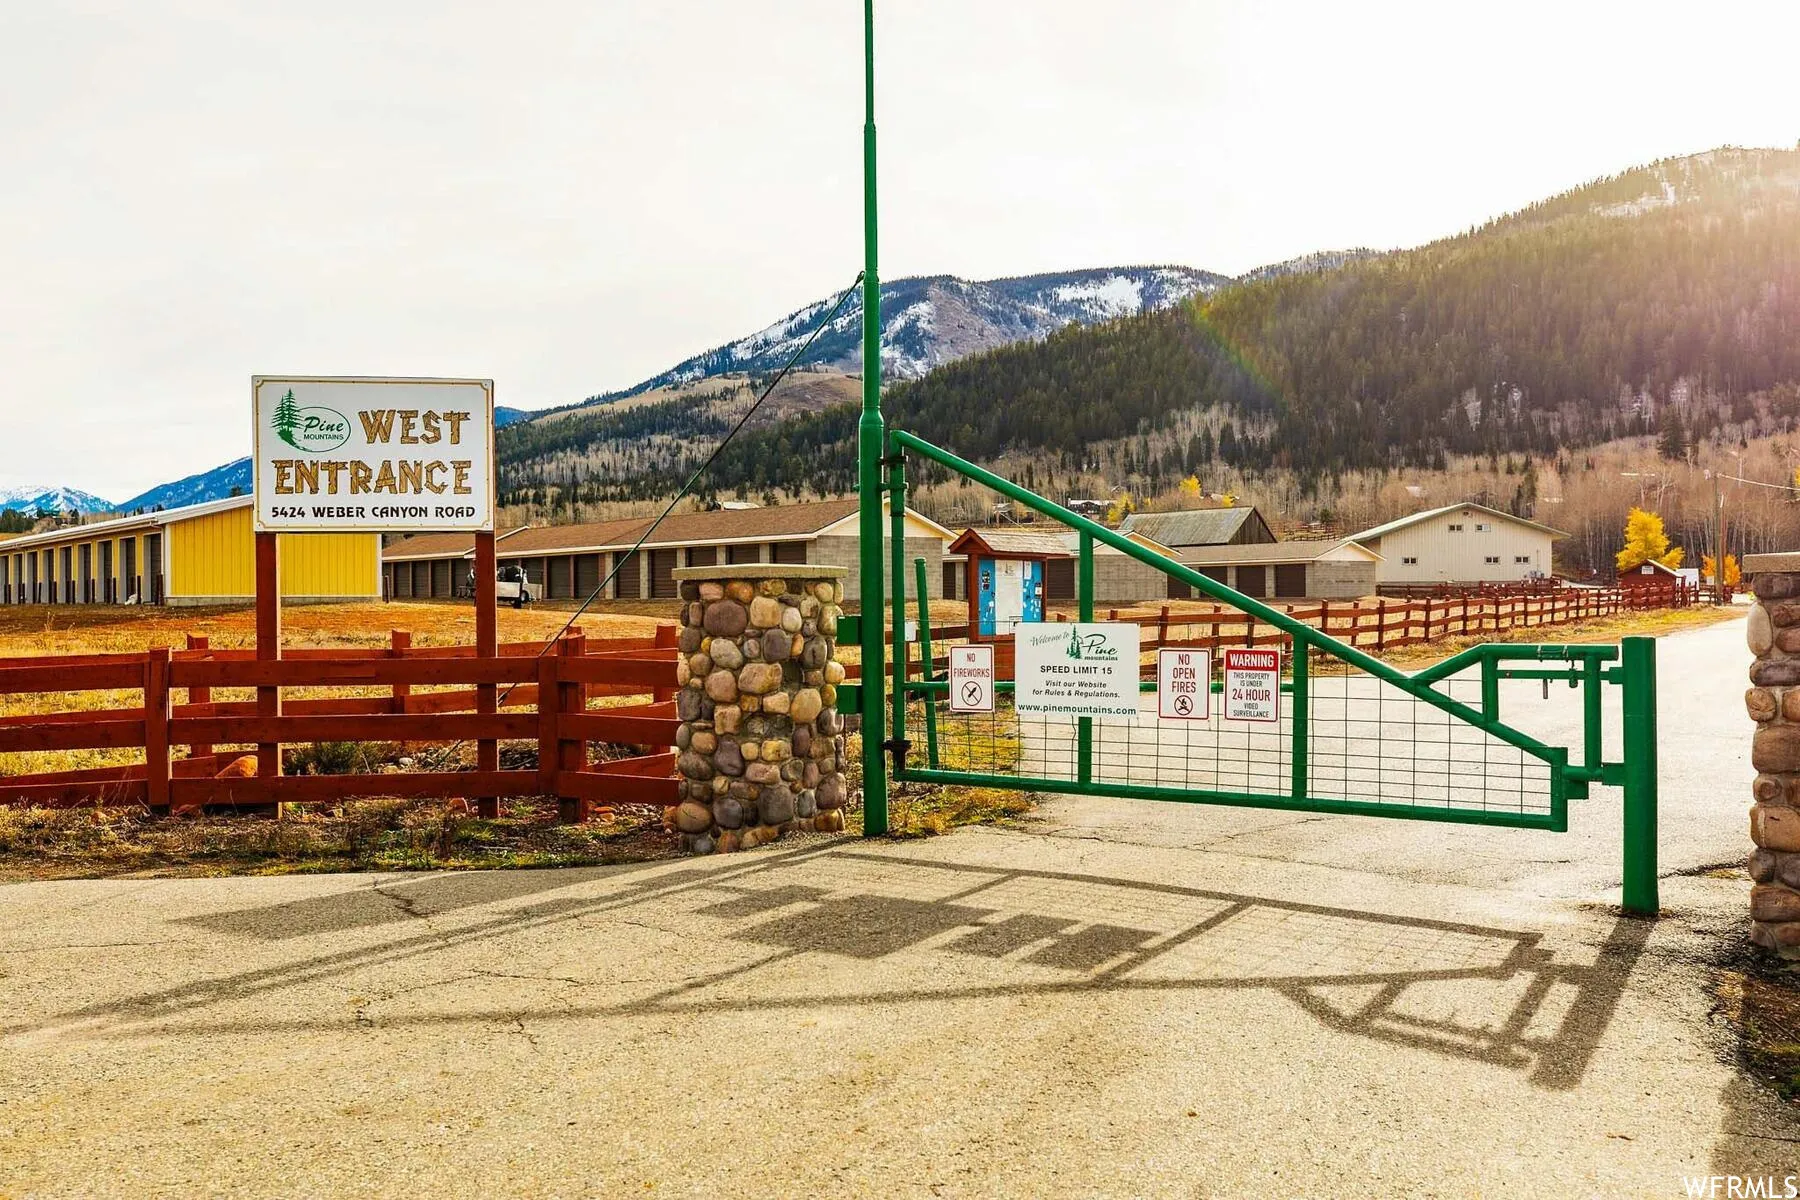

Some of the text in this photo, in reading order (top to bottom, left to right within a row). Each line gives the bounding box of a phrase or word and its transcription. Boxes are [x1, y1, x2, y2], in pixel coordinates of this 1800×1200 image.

[304, 416, 344, 432] Pine
[358, 409, 470, 445] WEST
[271, 459, 473, 495] ENTRANCE
[271, 507, 476, 518] 5424 WEBER CANYON ROAD
[1030, 634, 1061, 646] Welcome
[1082, 633, 1118, 654] Pine
[966, 652, 976, 663] NO
[1178, 653, 1190, 665] NO
[1229, 653, 1275, 668] WARNING
[953, 667, 990, 678] FIREWORKS
[1040, 665, 1113, 675] SPEED LIMIT 15
[1172, 667, 1196, 680] OPEN
[1233, 672, 1270, 681] THIS PROPERTY
[1171, 681, 1197, 693] FIRES
[1246, 680, 1263, 688] UNDER
[1032, 688, 1120, 699] for Rules & Regulations.
[1232, 688, 1271, 702] 24 HOUR
[1018, 703, 1137, 715] www.pinemountains.com
[1243, 702, 1259, 710] VIDEO
[1233, 709, 1269, 719] SURVEILLANCE
